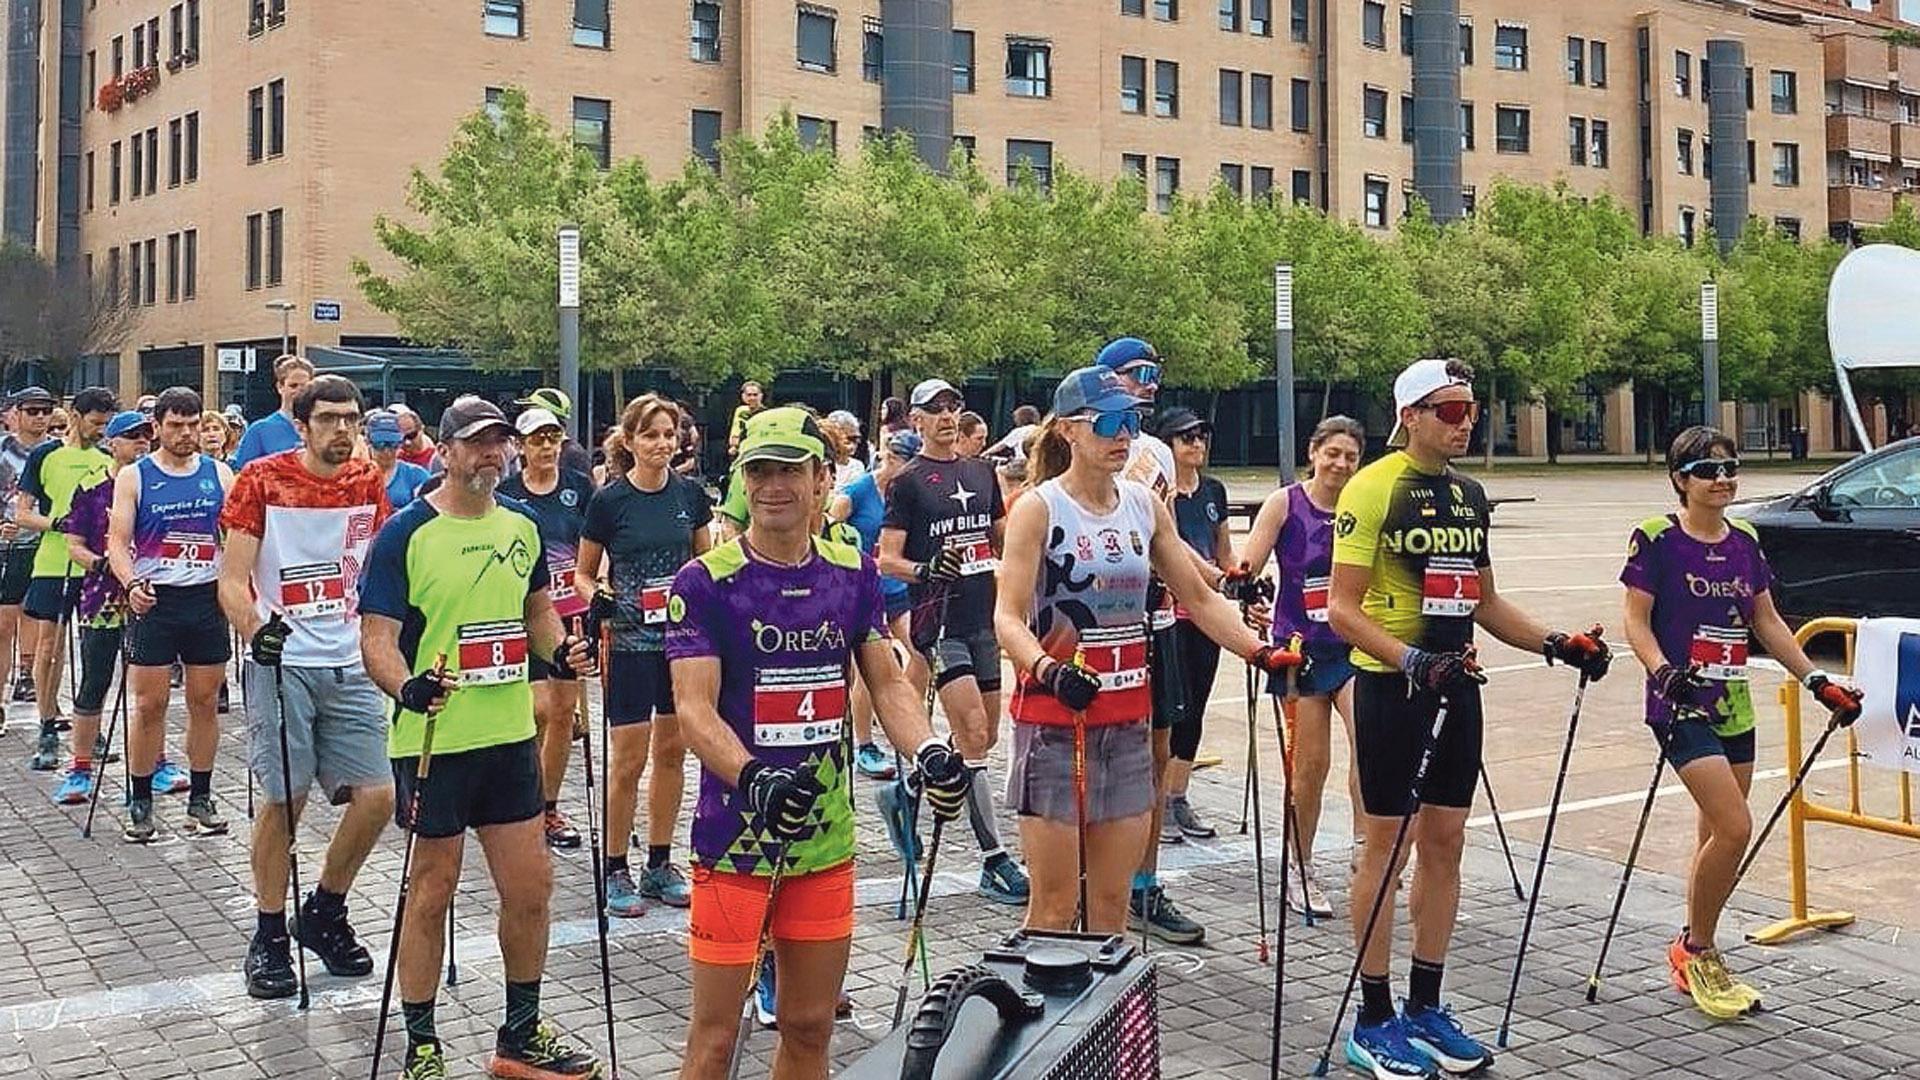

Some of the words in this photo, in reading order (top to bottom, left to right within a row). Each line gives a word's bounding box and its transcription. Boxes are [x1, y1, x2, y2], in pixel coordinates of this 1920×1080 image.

[929, 518, 954, 537] NW
[178, 544, 199, 560] 20
[1383, 527, 1484, 554] NORDIC
[304, 580, 327, 602] 12
[1454, 575, 1463, 598] 2
[492, 641, 505, 667] 8
[1111, 646, 1121, 672] 1
[1721, 643, 1733, 665] 3
[797, 690, 816, 721] 4
